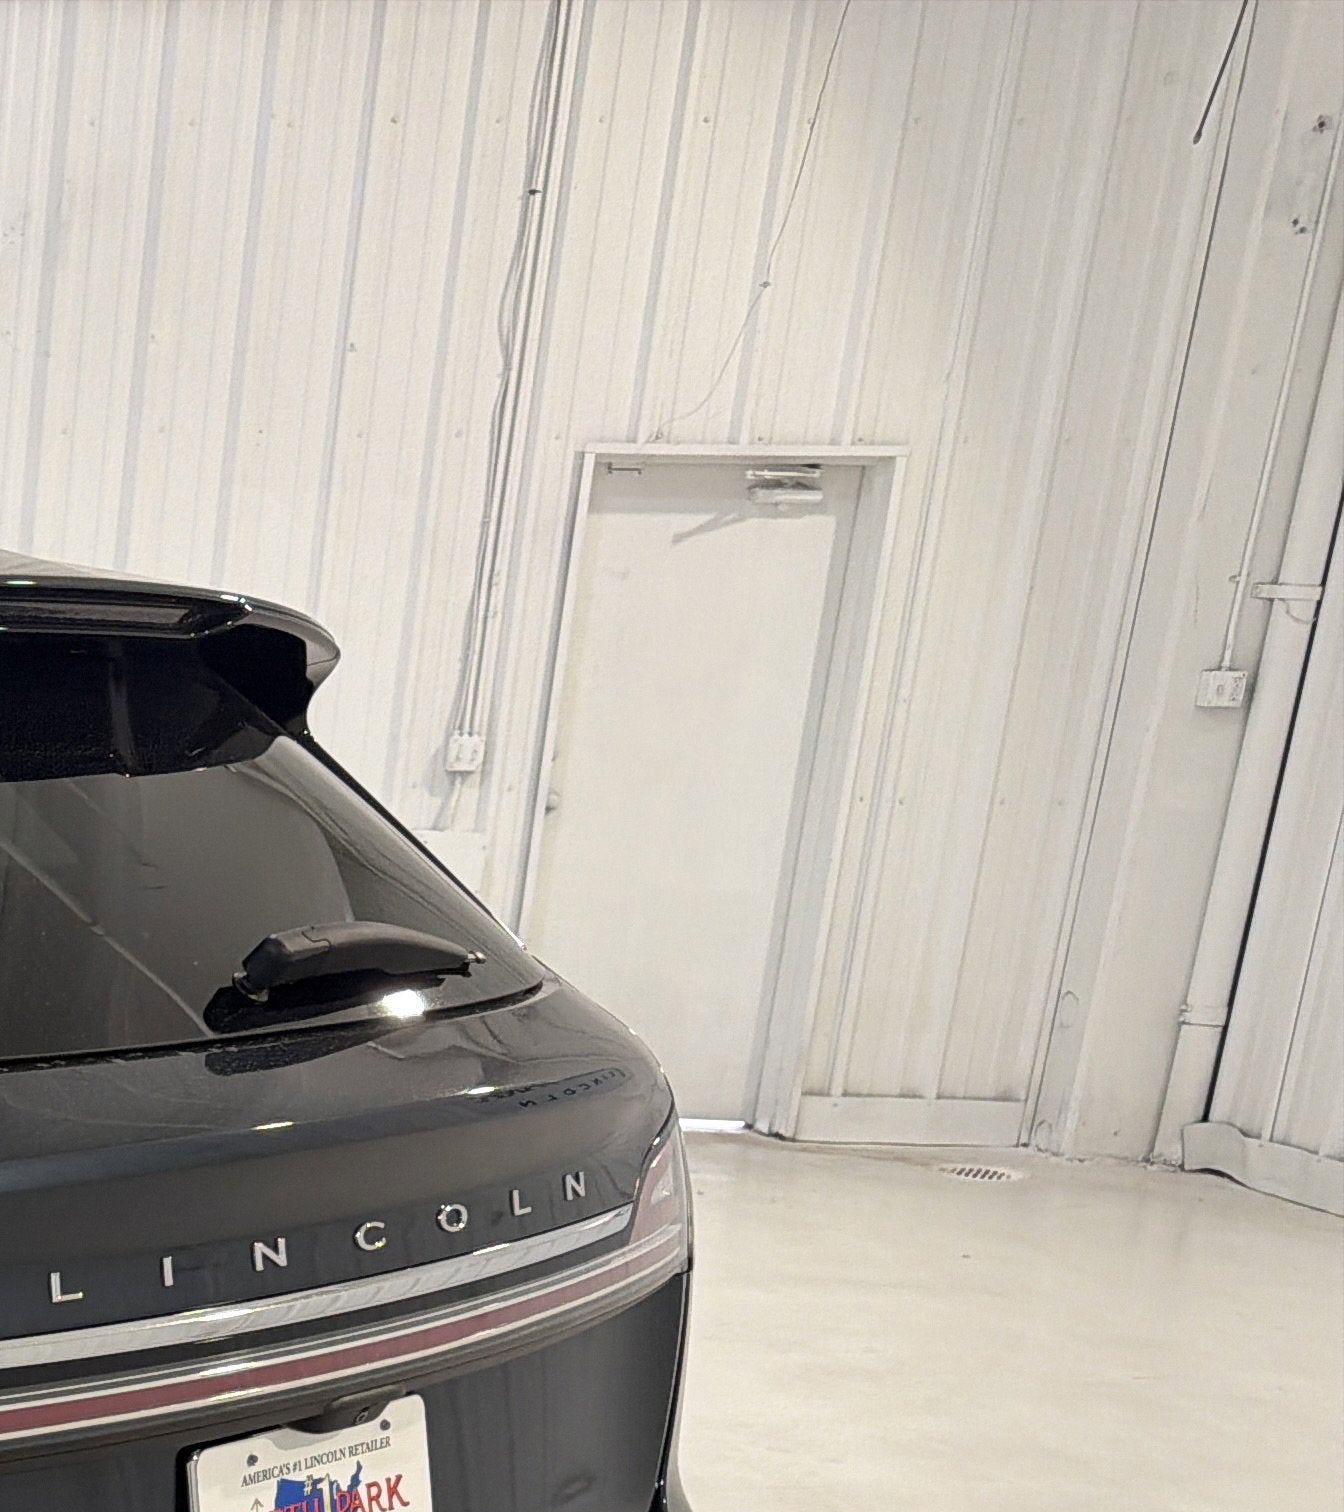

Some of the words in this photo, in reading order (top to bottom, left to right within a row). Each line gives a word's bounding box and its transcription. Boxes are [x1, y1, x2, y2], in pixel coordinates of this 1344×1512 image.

[49, 1171, 587, 1303] LINCOLN
[241, 1462, 291, 1488] AMERICA'S
[292, 1460, 303, 1473] #1
[304, 1446, 347, 1470] LINCOLN
[347, 1436, 391, 1457] RETAILER
